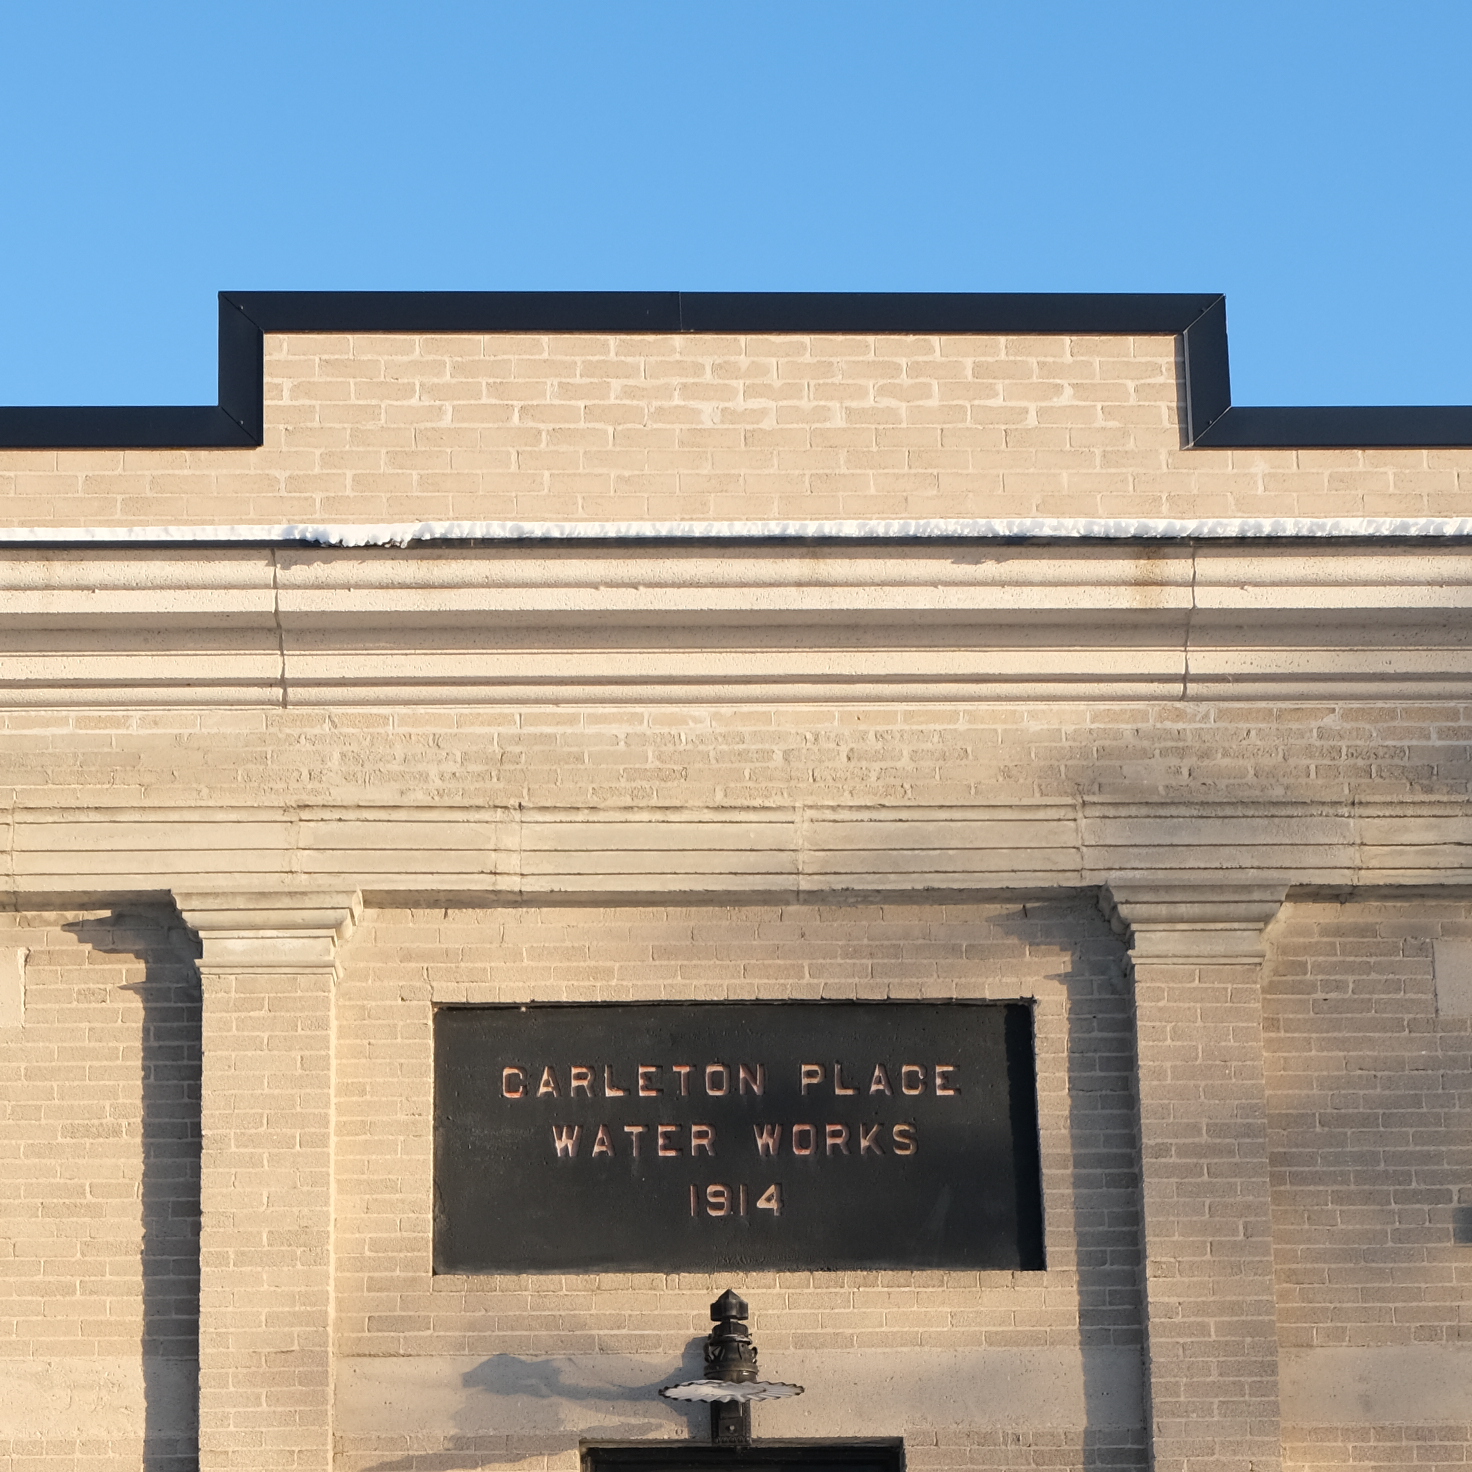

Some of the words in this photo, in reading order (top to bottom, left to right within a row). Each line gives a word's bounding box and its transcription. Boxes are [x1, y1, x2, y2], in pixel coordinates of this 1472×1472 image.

[501, 1063, 765, 1098] CARLETON
[801, 1063, 961, 1096] PLACE
[552, 1123, 717, 1158] WATER
[753, 1122, 918, 1156] WORKS
[689, 1183, 783, 1217] 1914
